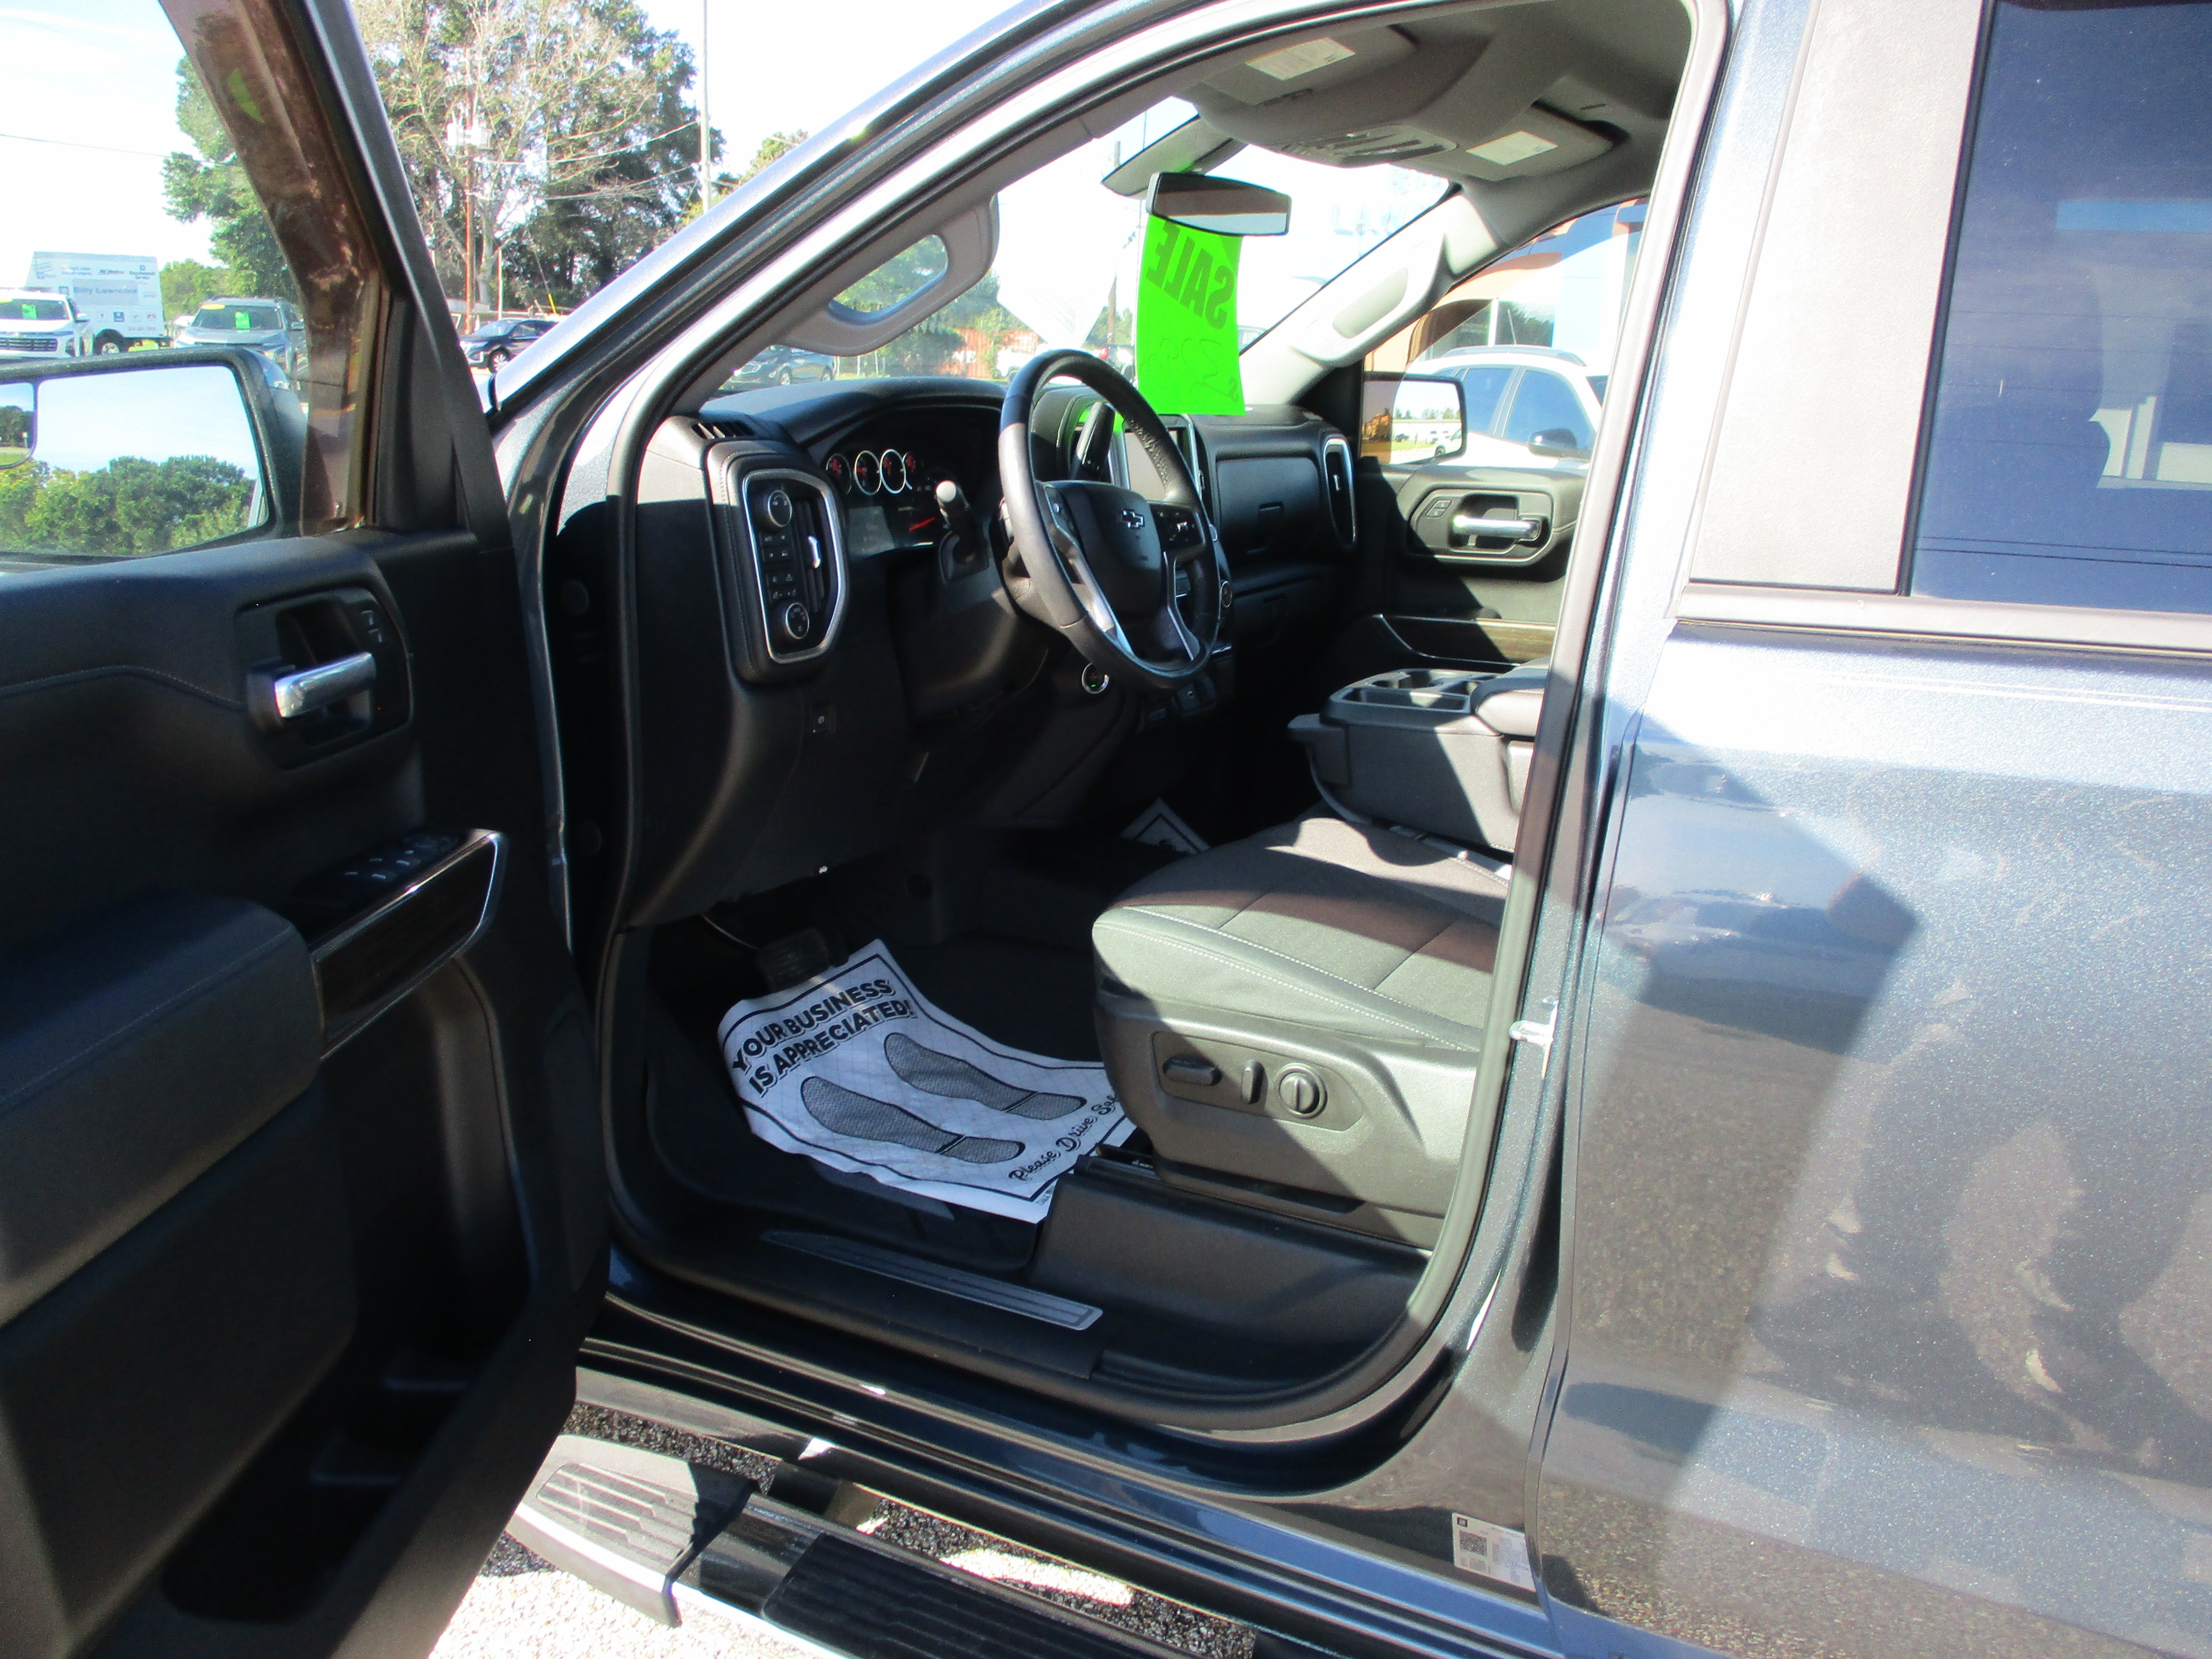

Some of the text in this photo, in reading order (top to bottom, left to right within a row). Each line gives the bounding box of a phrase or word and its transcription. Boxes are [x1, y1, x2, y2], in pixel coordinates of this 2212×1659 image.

[732, 979, 896, 1073] YOUR BUSINESS
[748, 1000, 917, 1097] IS APPRECIATED!
[1009, 1150, 1061, 1181] Please
[1056, 1116, 1097, 1152] Drive
